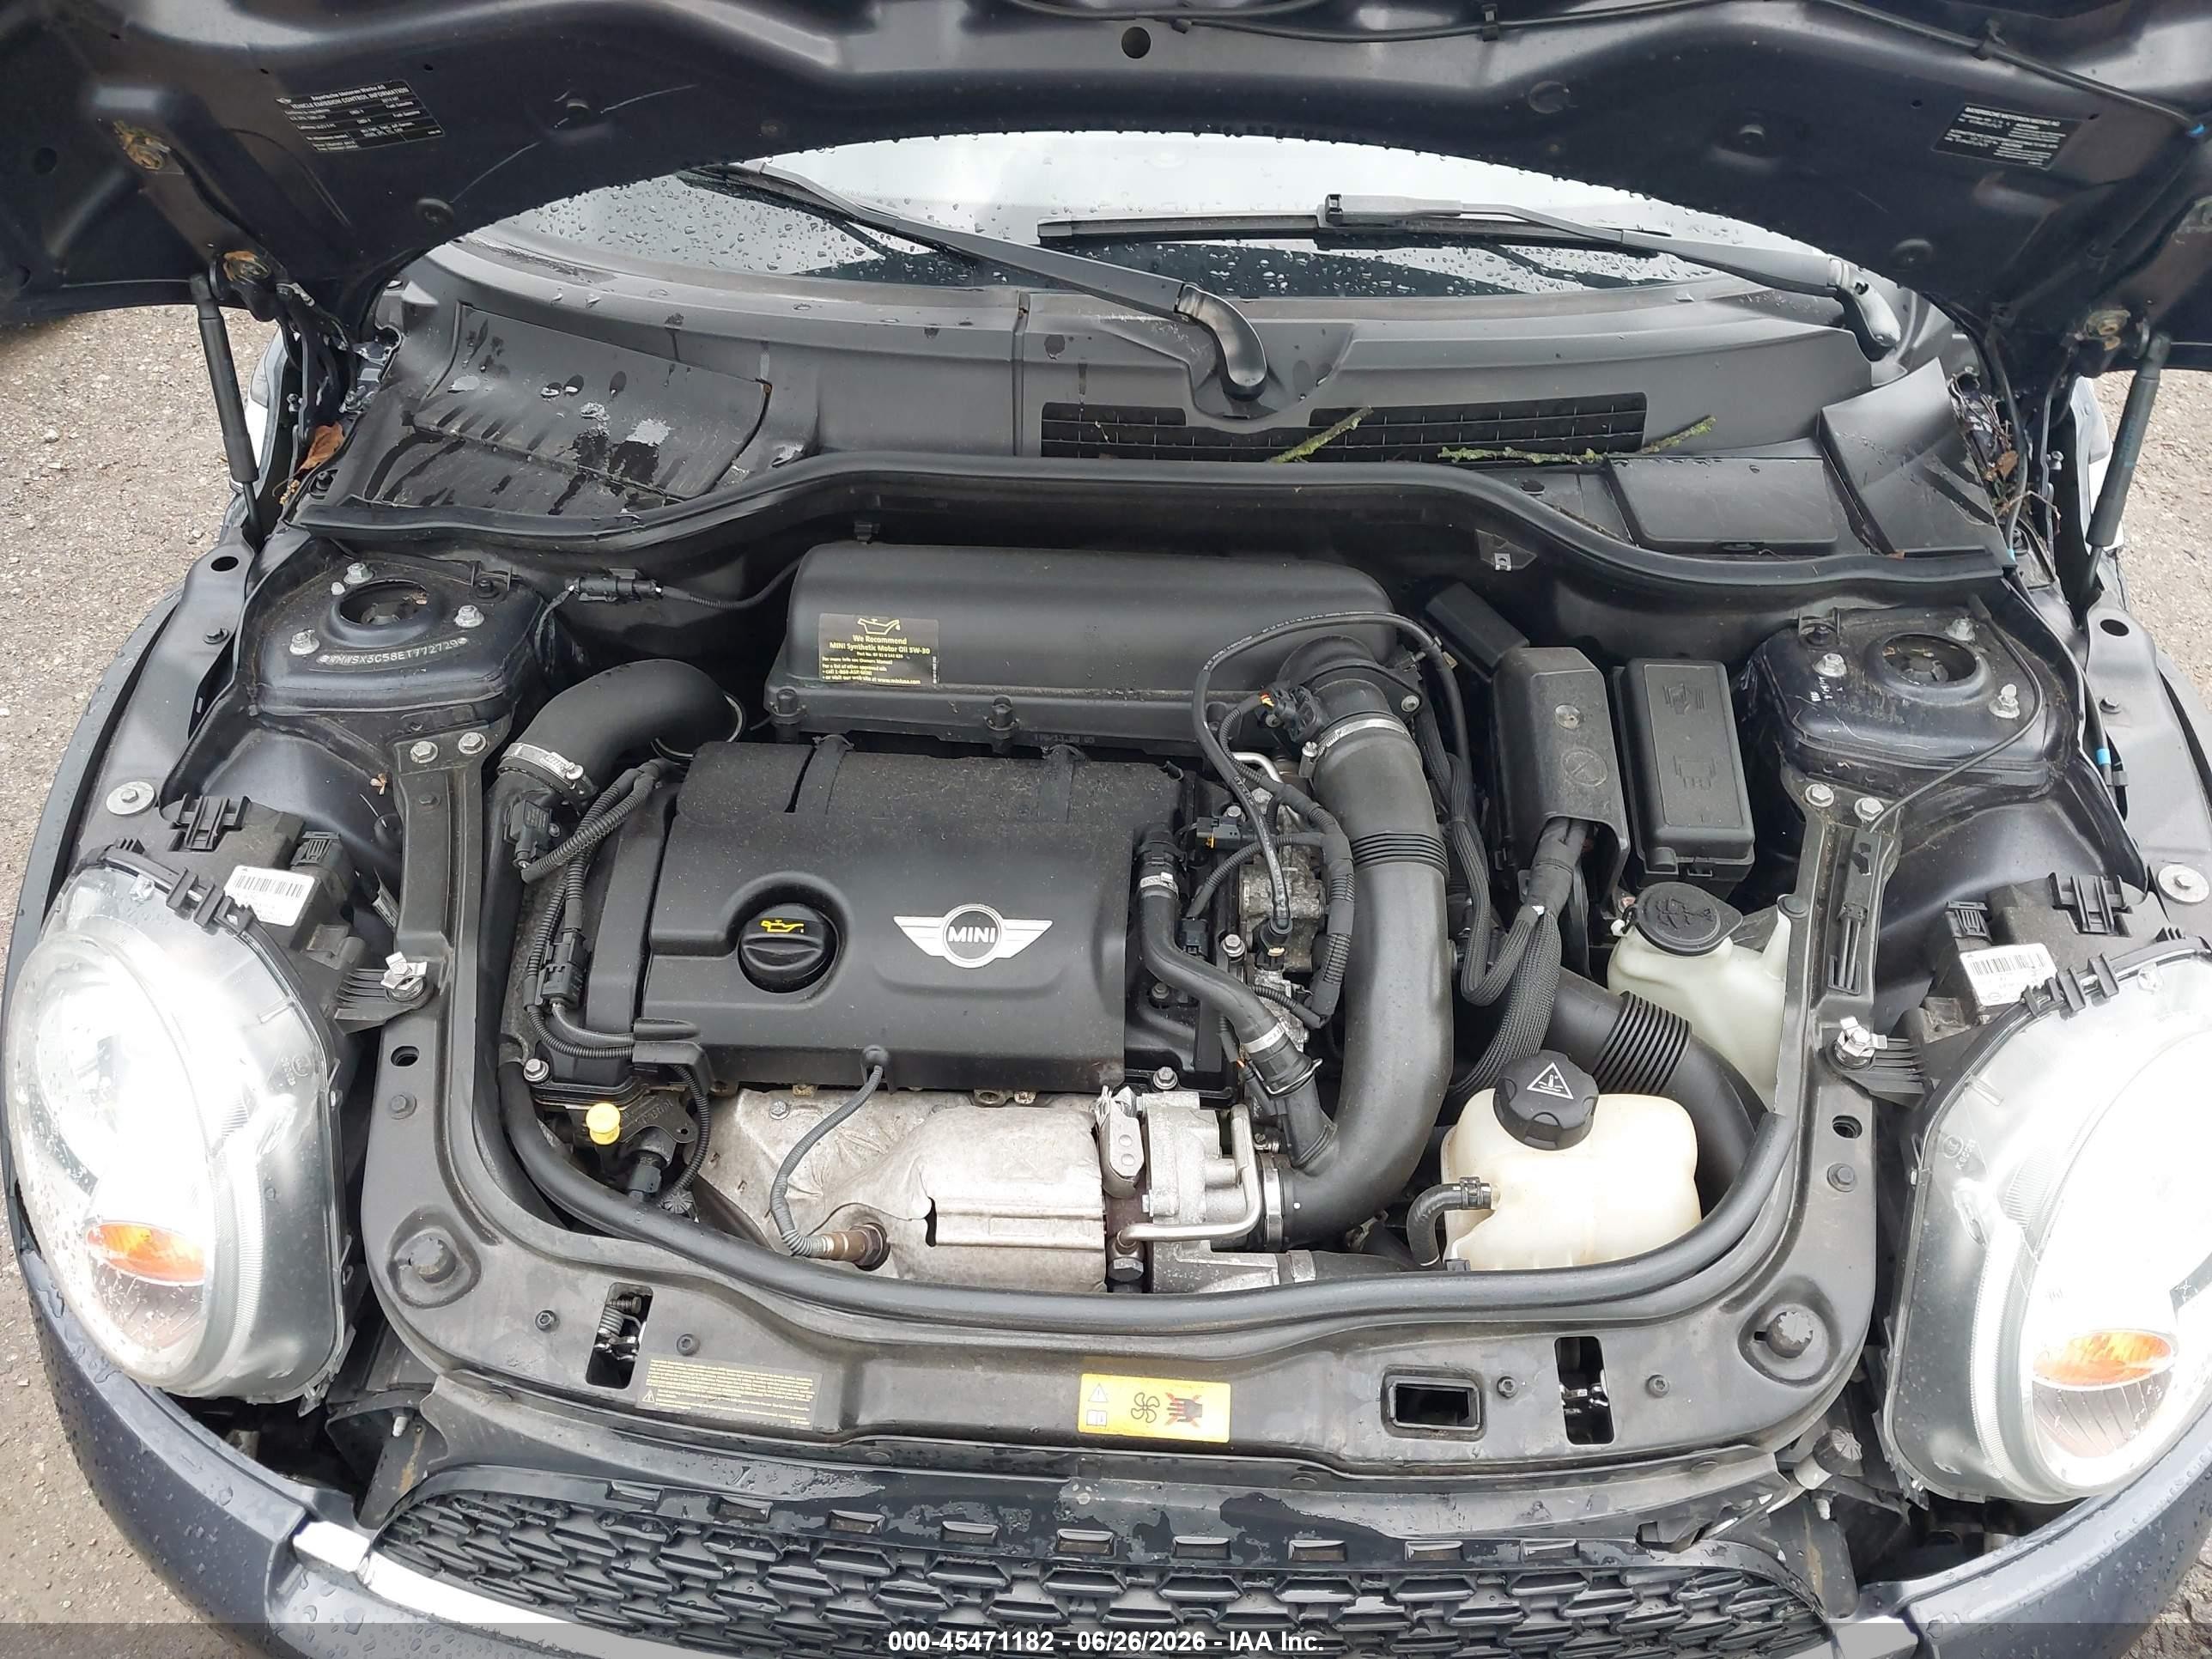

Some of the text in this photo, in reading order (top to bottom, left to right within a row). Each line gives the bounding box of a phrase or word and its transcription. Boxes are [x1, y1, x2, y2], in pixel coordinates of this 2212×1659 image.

[342, 94, 368, 104] CONTROL
[865, 635, 908, 645] Recommend
[847, 643, 877, 652] Synthetic
[948, 926, 996, 944] MINI
